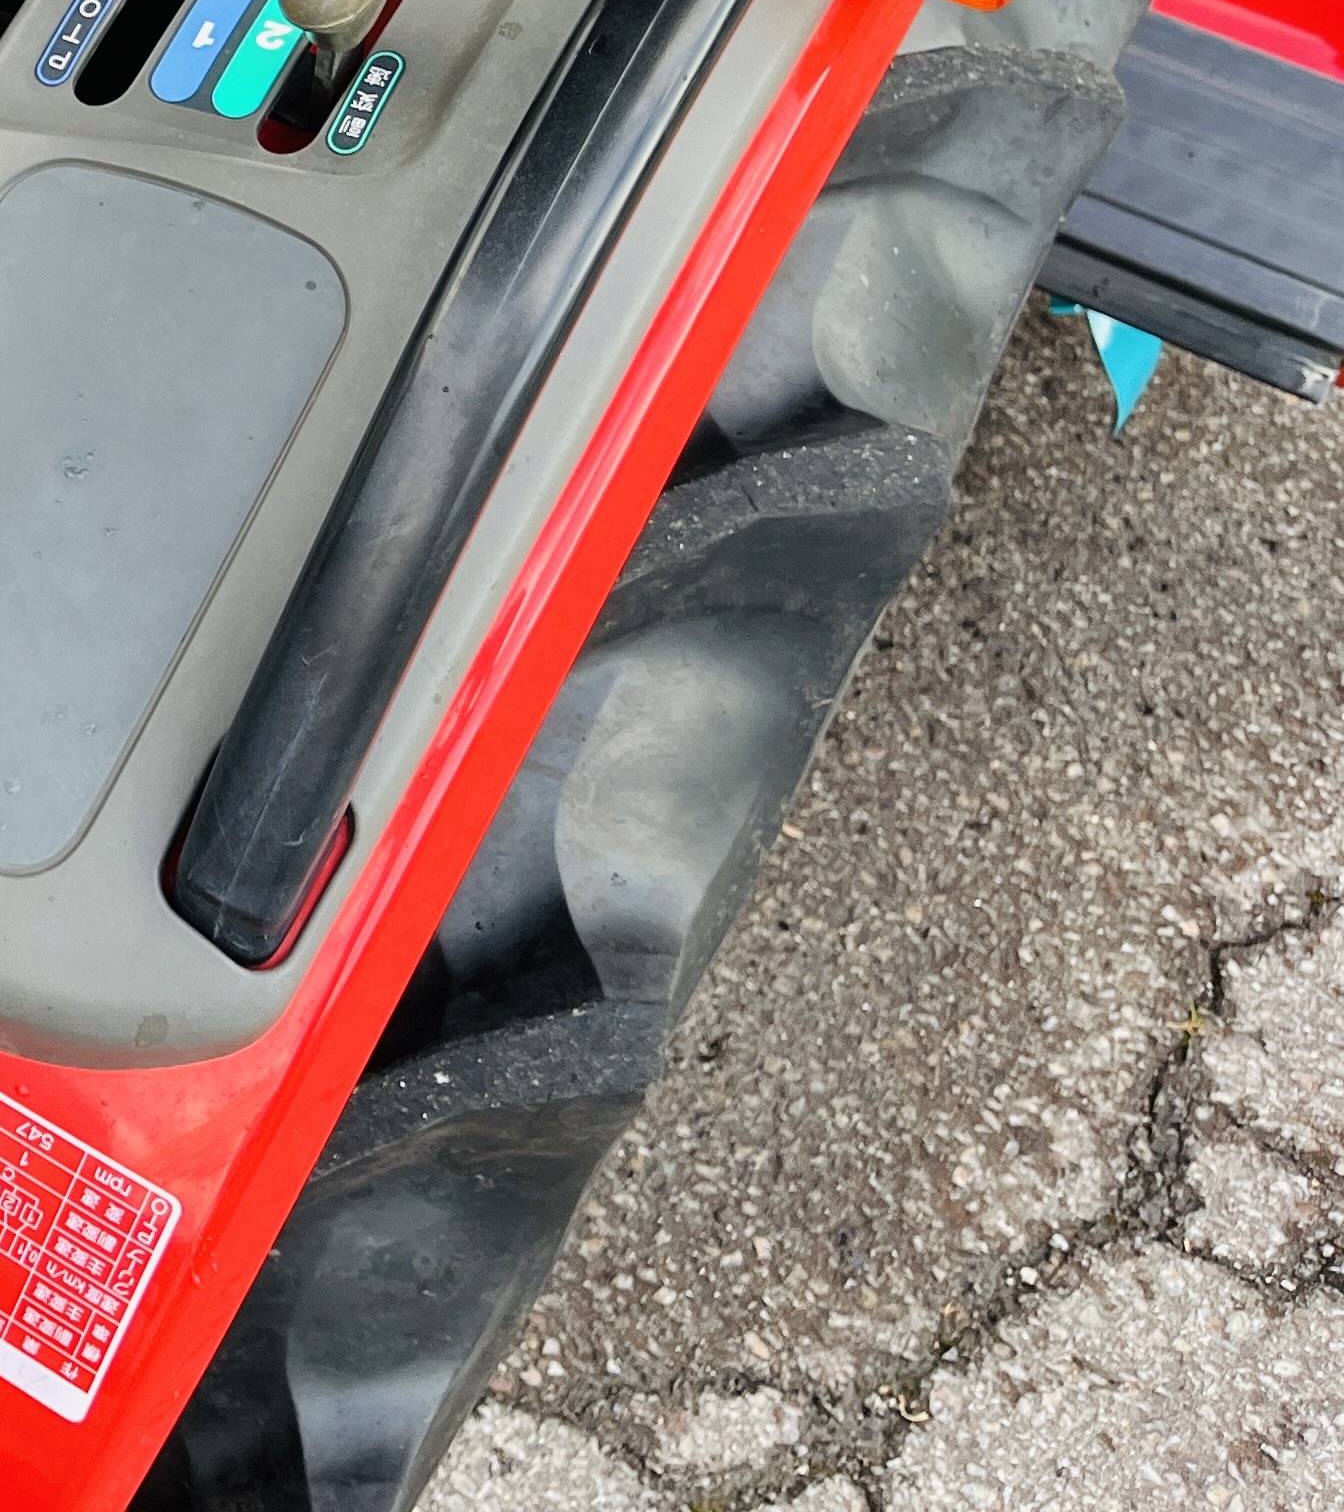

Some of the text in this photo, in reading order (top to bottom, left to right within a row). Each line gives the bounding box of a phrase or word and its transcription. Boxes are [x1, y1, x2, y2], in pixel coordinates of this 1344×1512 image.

[191, 20, 215, 48] 1
[256, 21, 294, 50] 2
[337, 63, 392, 140] 副変速
[15, 1121, 56, 1151] 547
[1, 1165, 16, 1181] C
[17, 1150, 33, 1168] 1
[92, 1166, 132, 1197] rpm
[1, 1194, 15, 1209] 2
[25, 1209, 37, 1223] 1
